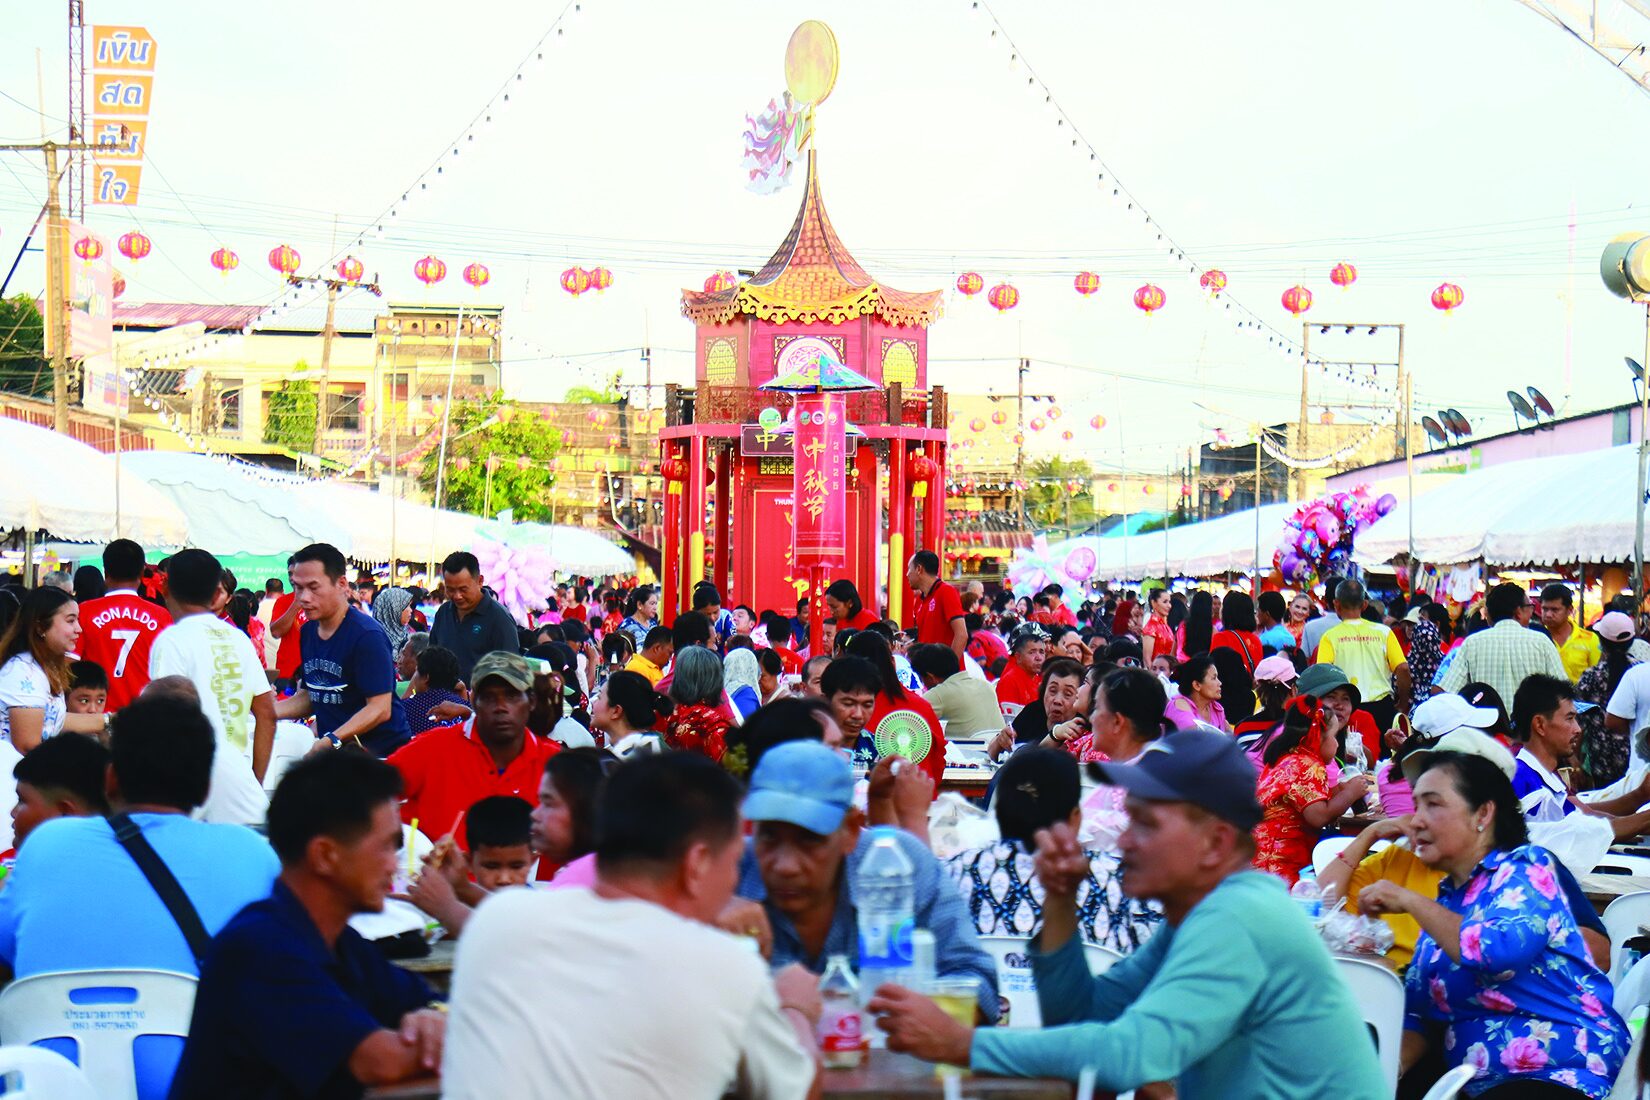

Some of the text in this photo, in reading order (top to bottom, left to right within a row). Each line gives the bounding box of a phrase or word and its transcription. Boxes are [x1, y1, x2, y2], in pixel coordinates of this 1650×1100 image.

[98, 33, 150, 62] เงิน
[101, 83, 143, 105] สด
[101, 171, 127, 200] ใจ
[92, 607, 158, 631] RONALDO
[111, 629, 140, 678] 7
